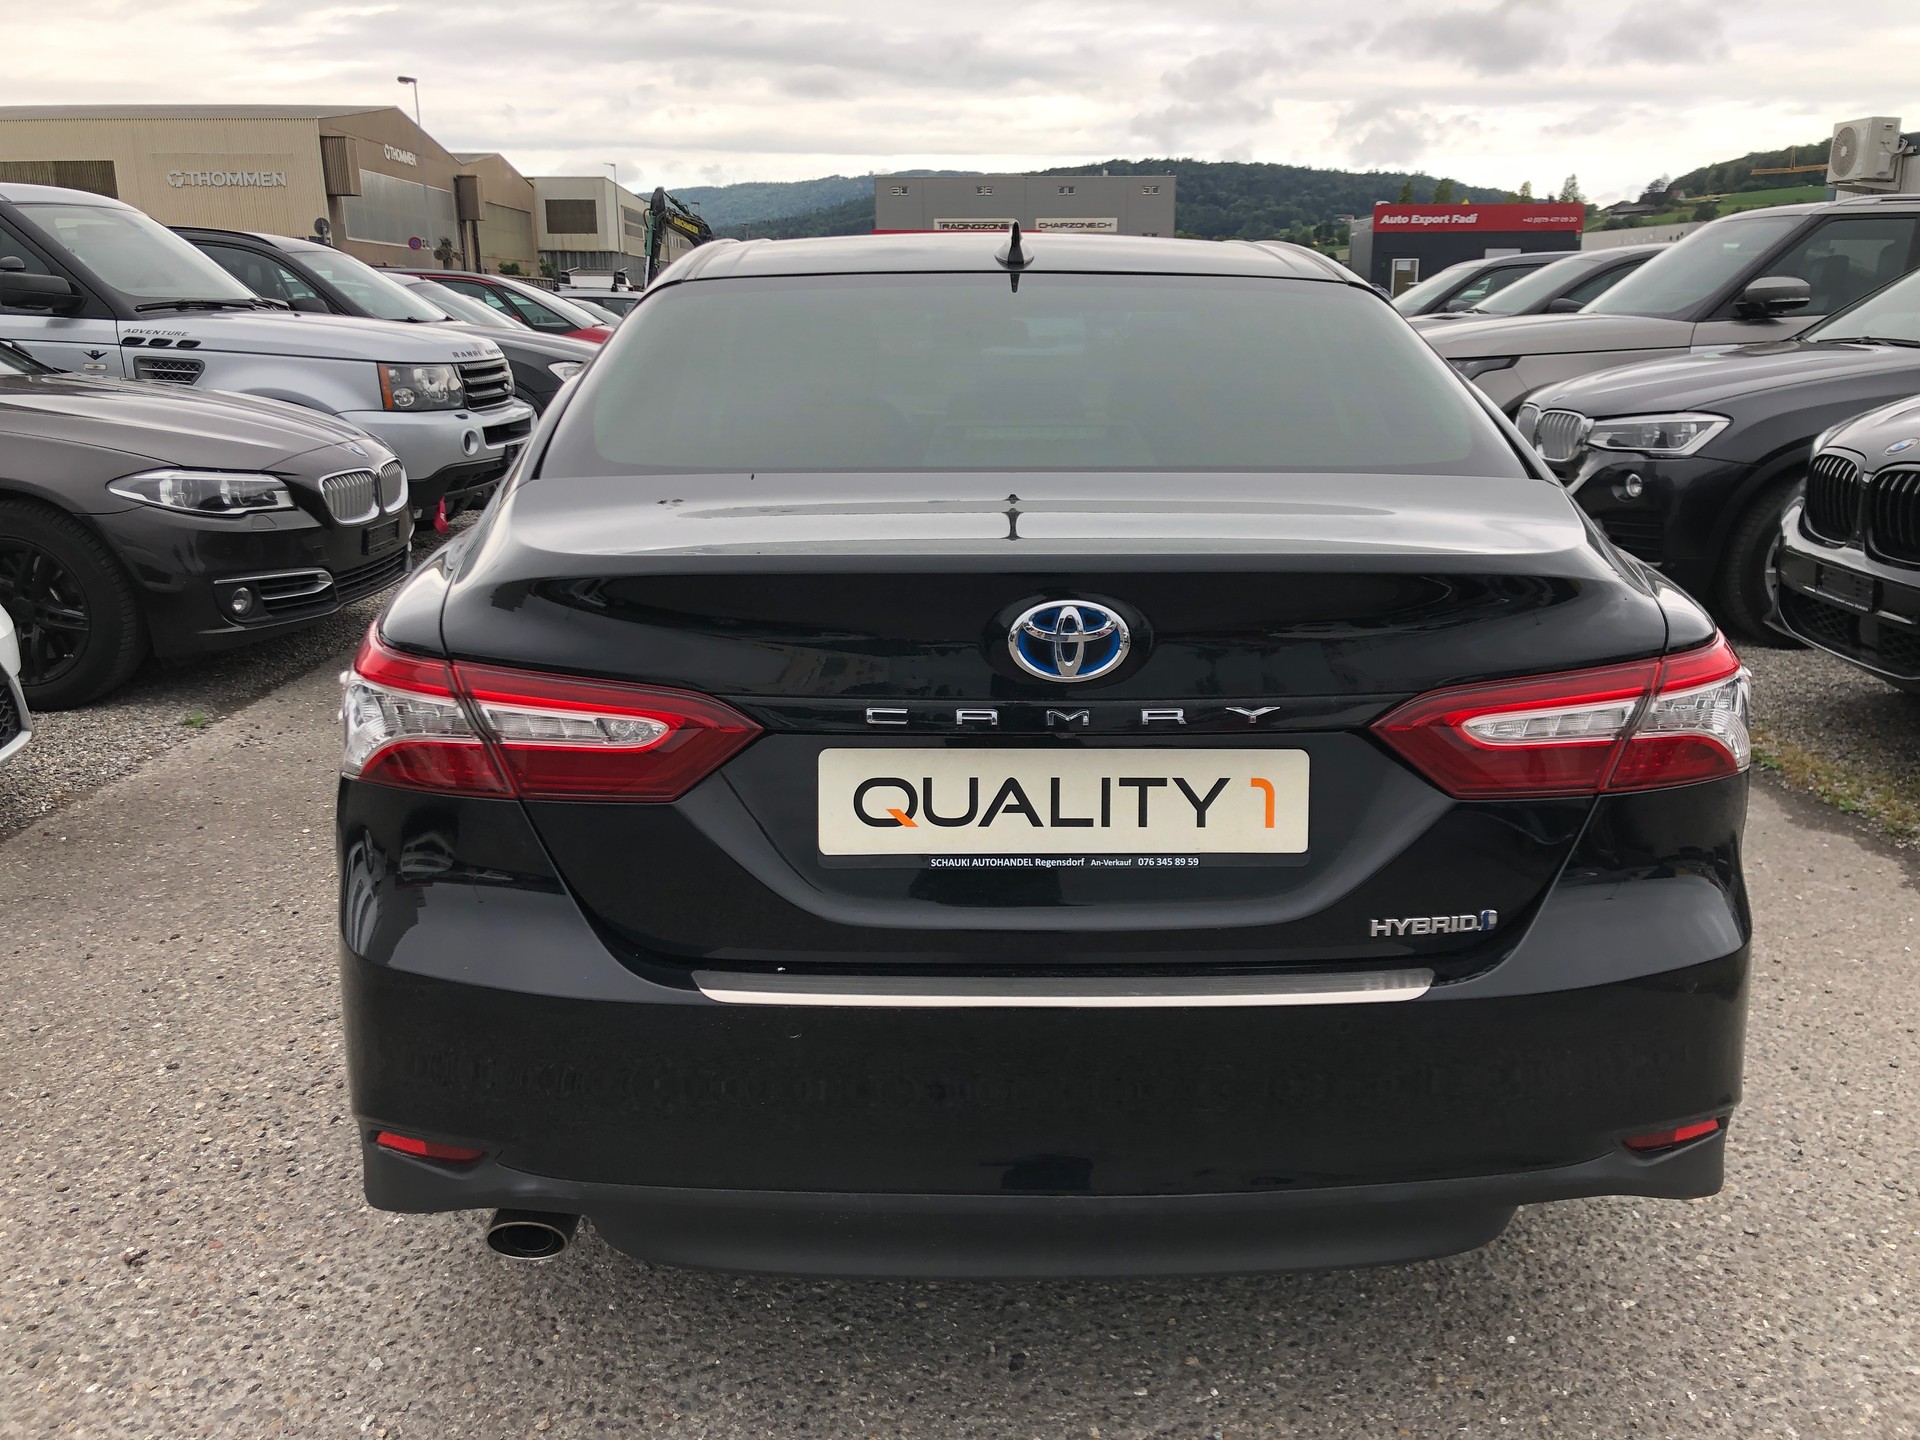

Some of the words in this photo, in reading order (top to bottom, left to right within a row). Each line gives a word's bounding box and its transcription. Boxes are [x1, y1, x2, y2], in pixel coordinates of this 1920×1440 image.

[389, 146, 417, 167] THOMMEN
[184, 171, 287, 188] THOMMEN
[1380, 215, 1409, 224] Auto
[1410, 215, 1449, 226] Export
[1451, 213, 1478, 224] Fadi
[124, 328, 189, 337] ADVENTURE
[865, 706, 1281, 726] CAMRY
[853, 777, 1231, 828] QUALITY
[1250, 778, 1276, 829] 1
[930, 858, 970, 867] SCHAUKI
[971, 858, 1033, 867] AUTOHANDEL
[1035, 857, 1085, 868] Regensdorf
[1090, 858, 1132, 866] An-Verkauf
[1138, 857, 1155, 866] 076
[1156, 857, 1173, 866] 345
[1174, 857, 1186, 866] 89
[1187, 857, 1200, 866] 59
[1370, 914, 1478, 937] HYBRID
